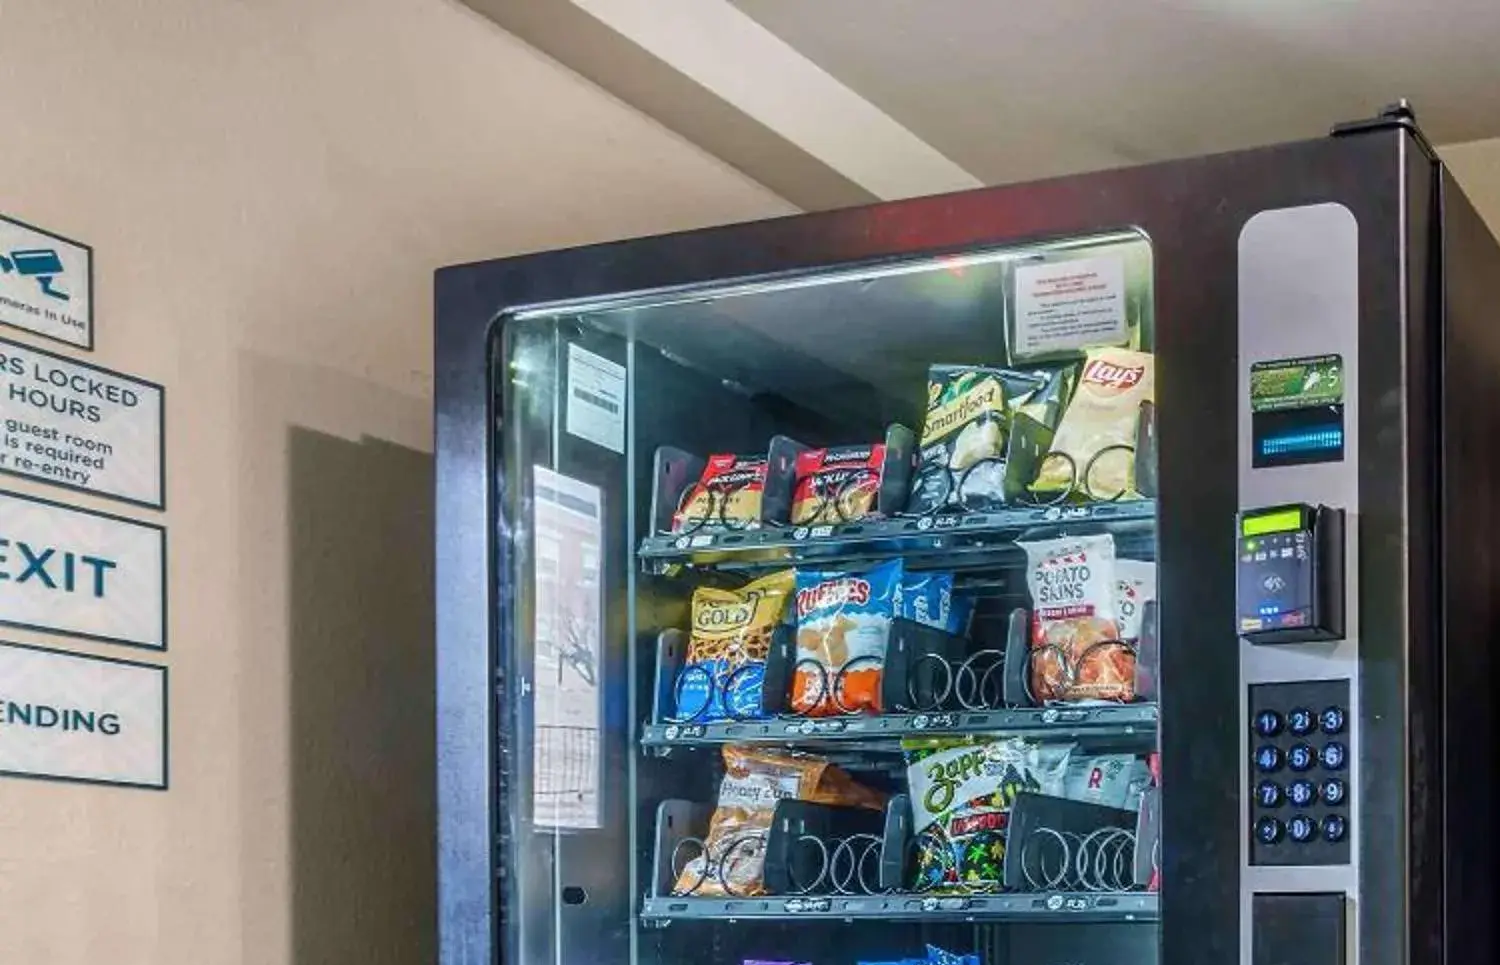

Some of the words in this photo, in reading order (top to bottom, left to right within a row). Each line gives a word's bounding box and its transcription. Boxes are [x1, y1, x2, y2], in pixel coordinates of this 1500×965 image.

[44, 308, 58, 322] In
[61, 313, 87, 331] Use
[9, 383, 102, 424] HOURS
[34, 363, 139, 408] LOCKED
[922, 385, 999, 438] Smartfood
[4, 433, 20, 449] is
[25, 441, 106, 472] required
[5, 418, 60, 442] guest
[65, 433, 114, 457] room
[14, 456, 92, 486] re-entry
[1040, 583, 1085, 602] SKINS
[698, 607, 750, 626] GOLD
